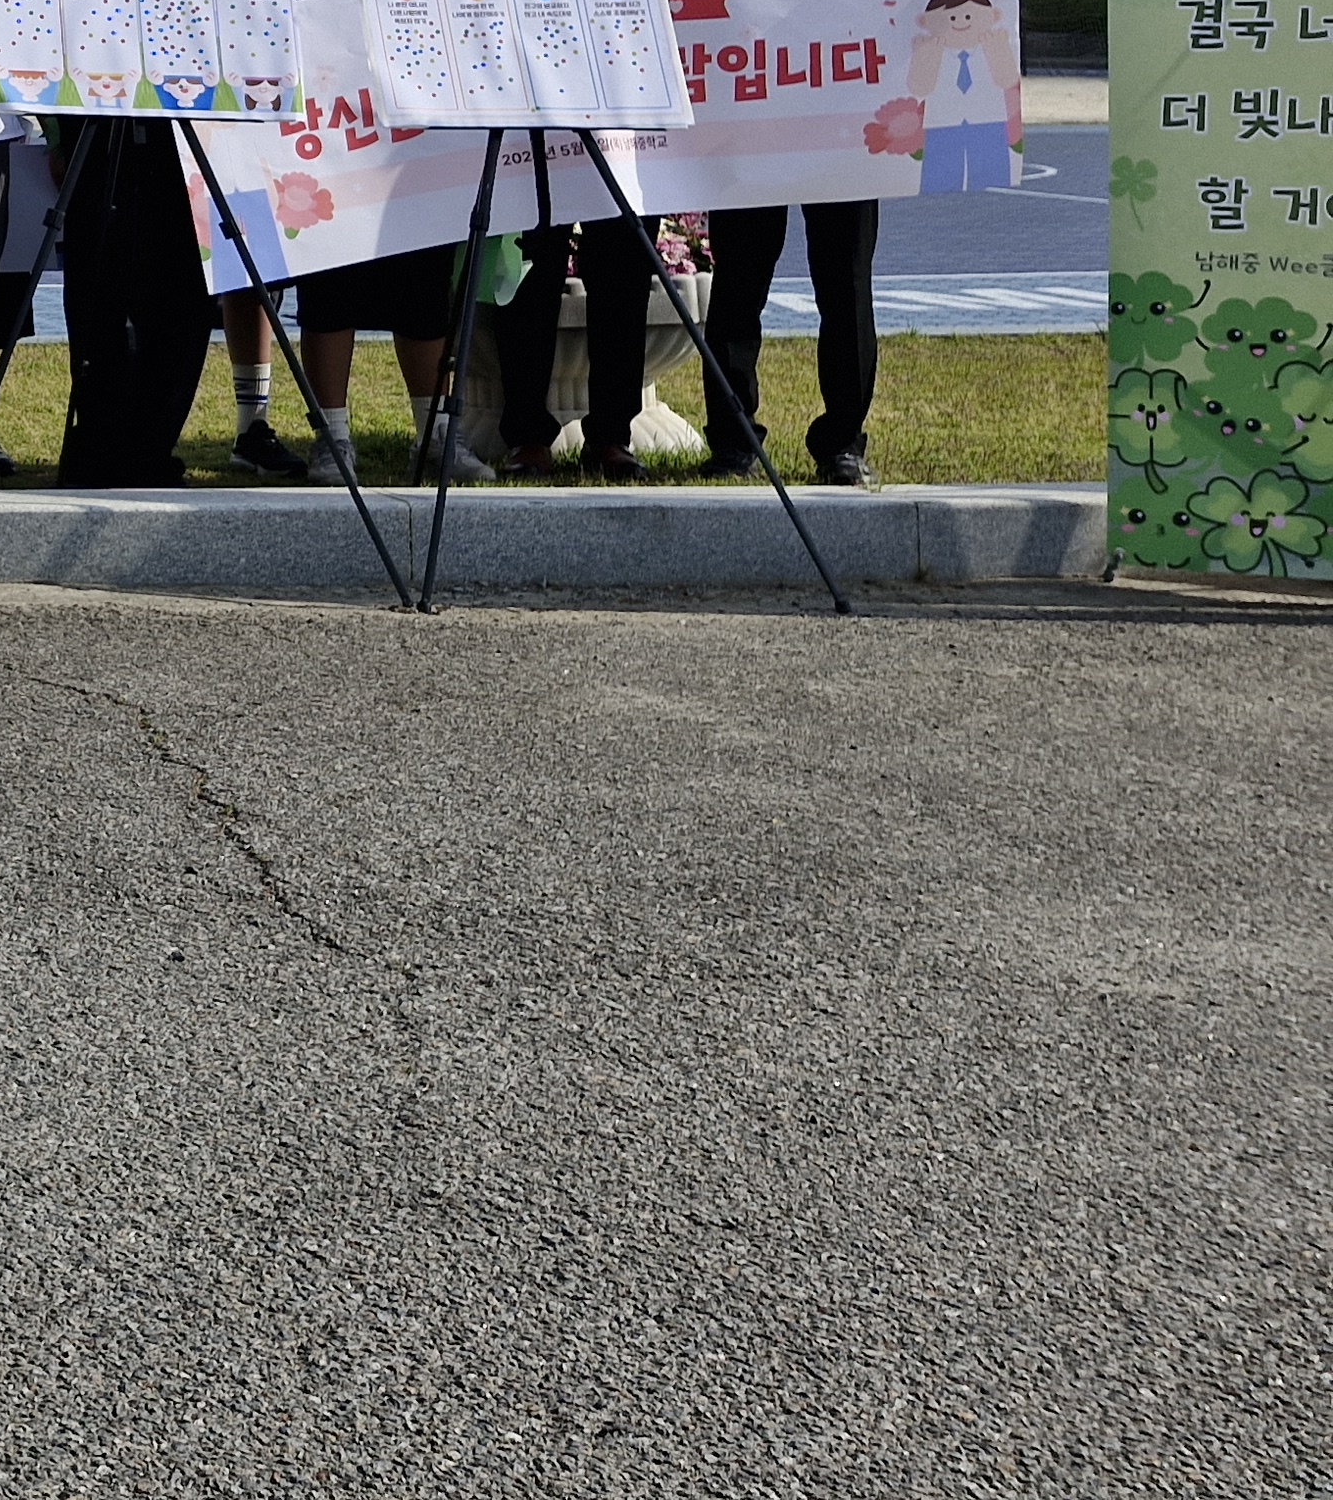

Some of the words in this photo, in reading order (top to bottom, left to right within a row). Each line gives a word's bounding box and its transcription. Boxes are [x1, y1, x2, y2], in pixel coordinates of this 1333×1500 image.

[278, 87, 426, 161] 당신
[1161, 94, 1207, 132] 더
[1198, 176, 1250, 231] 할
[1272, 187, 1333, 226] 거
[1195, 251, 1261, 276] 남해중
